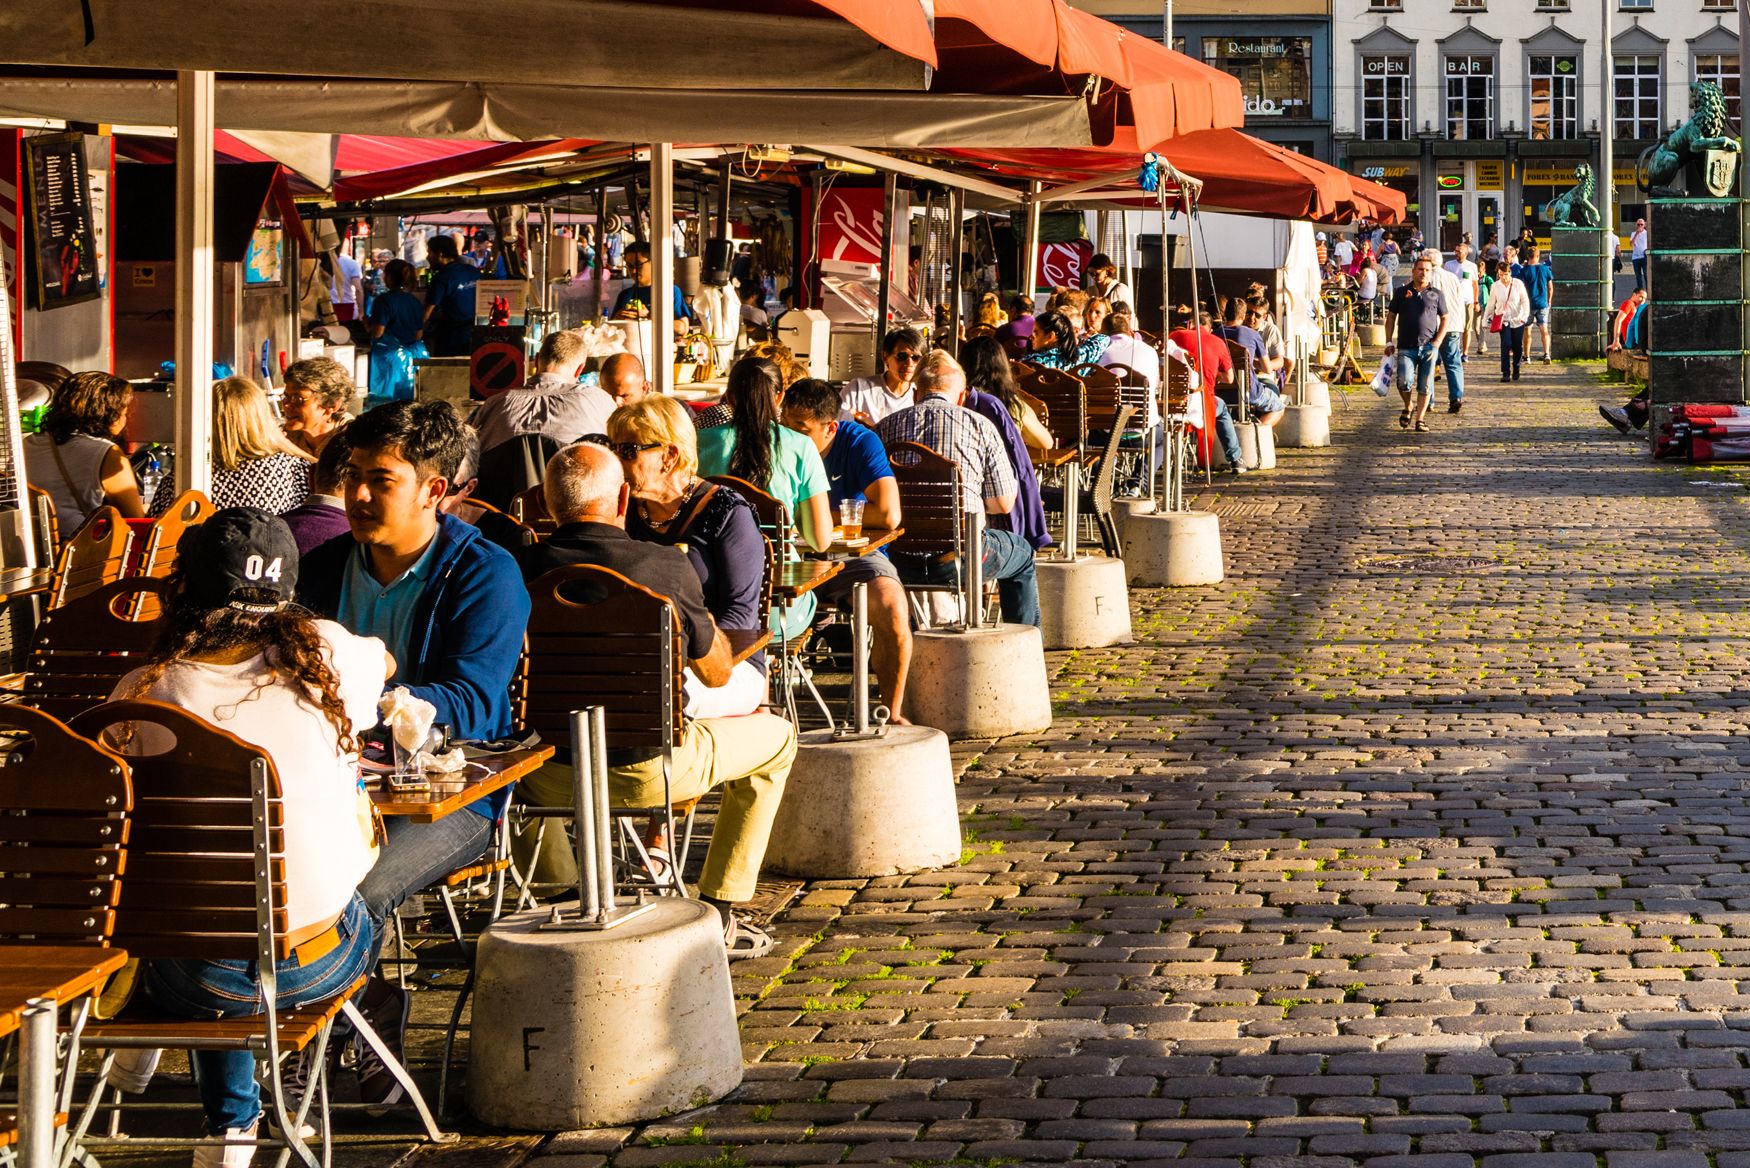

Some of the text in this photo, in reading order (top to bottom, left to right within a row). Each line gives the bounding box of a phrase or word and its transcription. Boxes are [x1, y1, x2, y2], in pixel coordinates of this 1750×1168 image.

[1228, 42, 1285, 53] Restaurant
[1368, 61, 1403, 72] OPEN
[1448, 61, 1480, 72] BAR
[1243, 94, 1276, 113] ido
[1361, 166, 1410, 177] SUBWAY
[245, 554, 283, 582] 04
[522, 1026, 545, 1072] F
